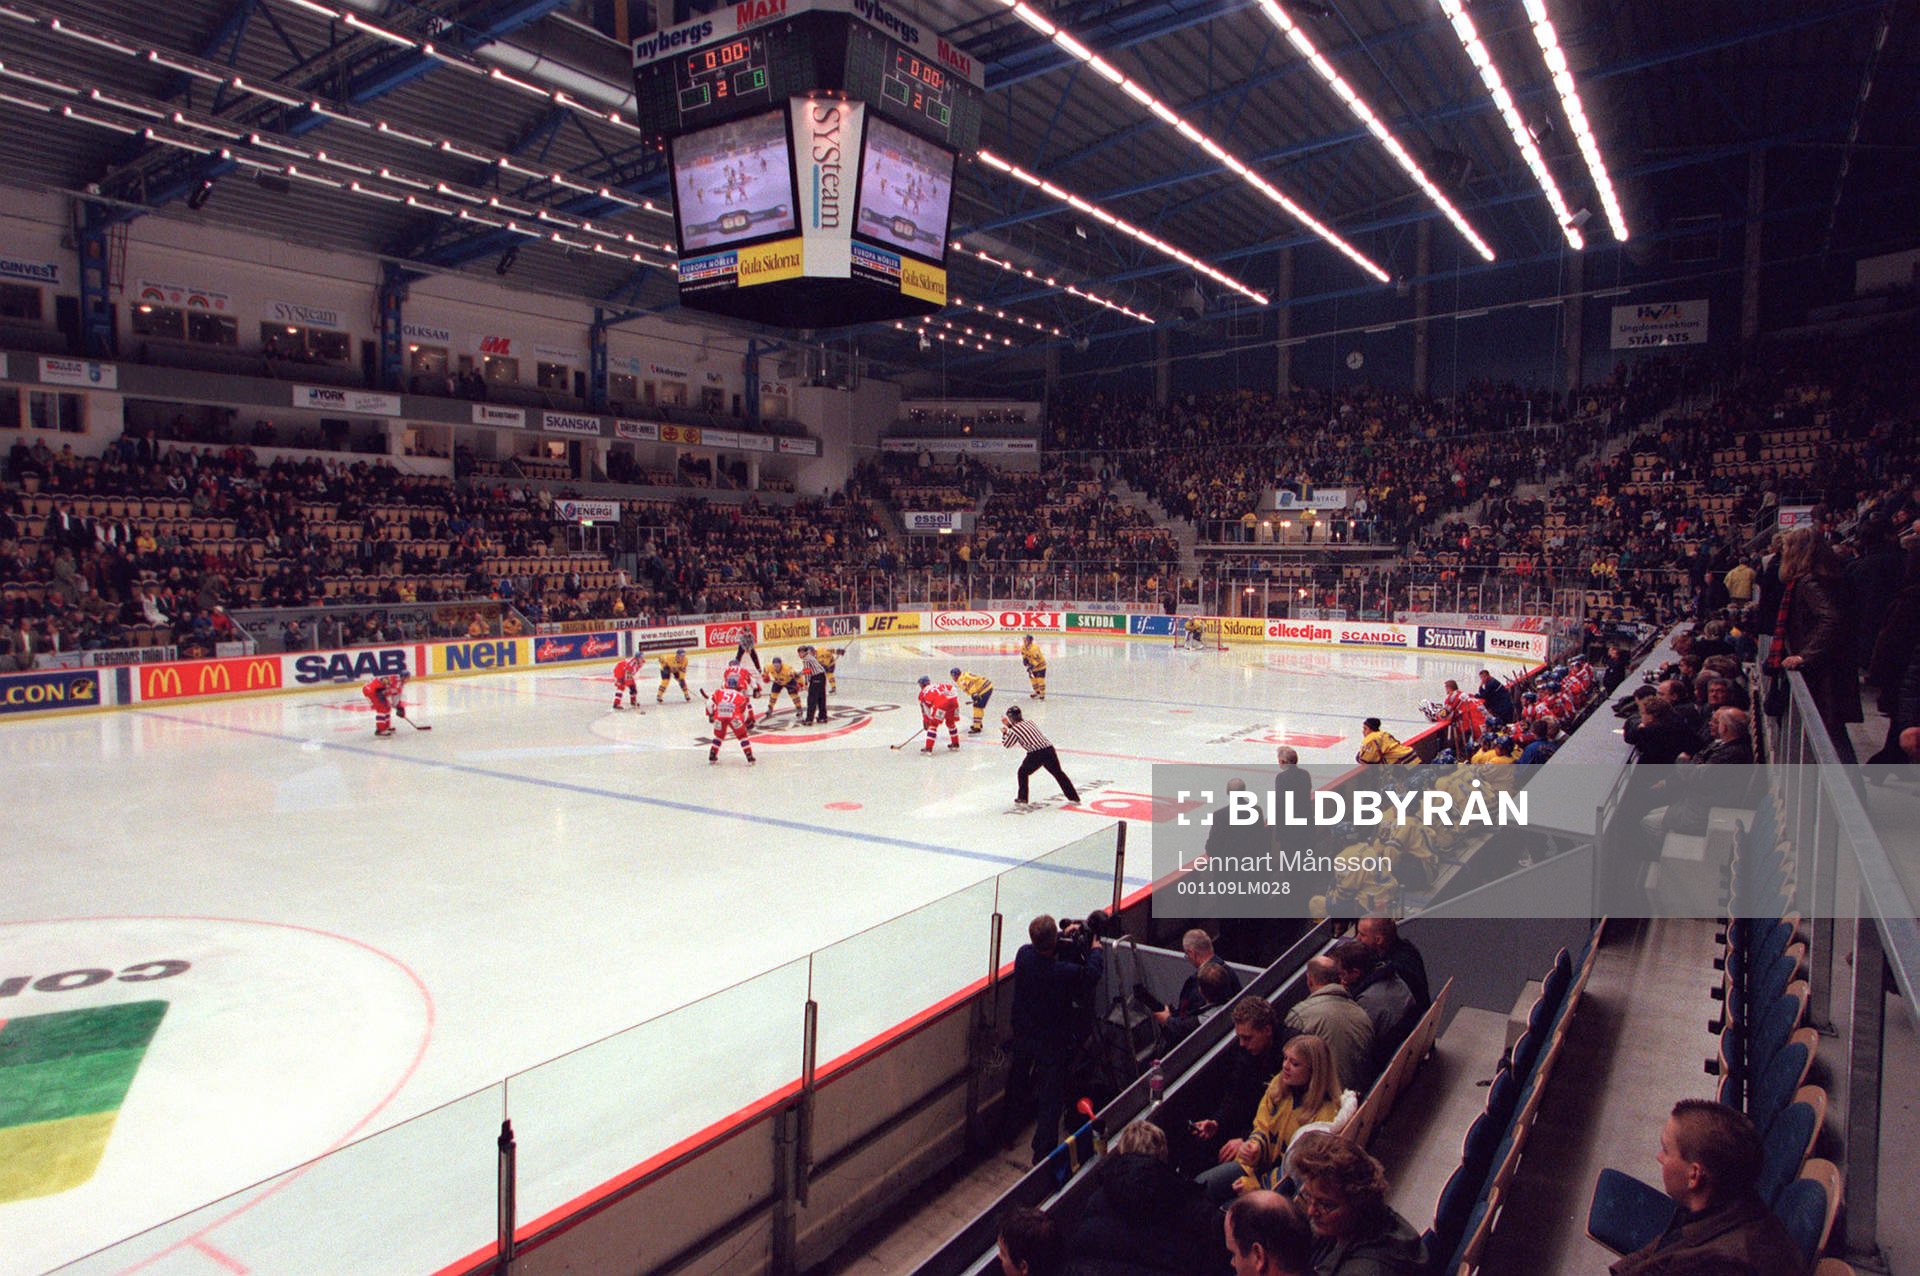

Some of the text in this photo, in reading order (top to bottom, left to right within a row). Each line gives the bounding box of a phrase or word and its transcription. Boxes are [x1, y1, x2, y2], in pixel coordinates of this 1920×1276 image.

[737, 0, 787, 26] MAXI
[637, 20, 713, 59] nybergs
[937, 37, 971, 76] MAXI
[753, 69, 765, 88] 0
[717, 80, 728, 98] 2
[913, 92, 922, 110] 2
[813, 106, 842, 229] SYSteam
[682, 261, 707, 273] EUROPA
[740, 253, 800, 275] Gula Sidorna
[902, 268, 945, 295] Gula Sidorna
[275, 303, 337, 321] SYSteam
[403, 325, 449, 341] OLKSAM
[318, 389, 345, 401] YORK
[546, 416, 598, 431] SKANSKA
[577, 507, 612, 516] ENERGI
[915, 513, 952, 522] essell
[279, 620, 307, 630] NC
[868, 617, 898, 631] JET
[940, 616, 990, 628] Stockmos
[999, 612, 1060, 627] OKI
[1078, 616, 1115, 628] SKYDDA
[1223, 620, 1263, 636] Sidorna
[709, 625, 745, 645] Coca-Col
[763, 620, 810, 641] Gula Sidorna
[1269, 623, 1332, 641] elkedjan
[1342, 631, 1407, 643] SCANDIC
[1425, 629, 1479, 649] STADIUM
[1491, 638, 1530, 650] expert
[295, 649, 407, 683] SAAB
[0, 682, 65, 705] CON
